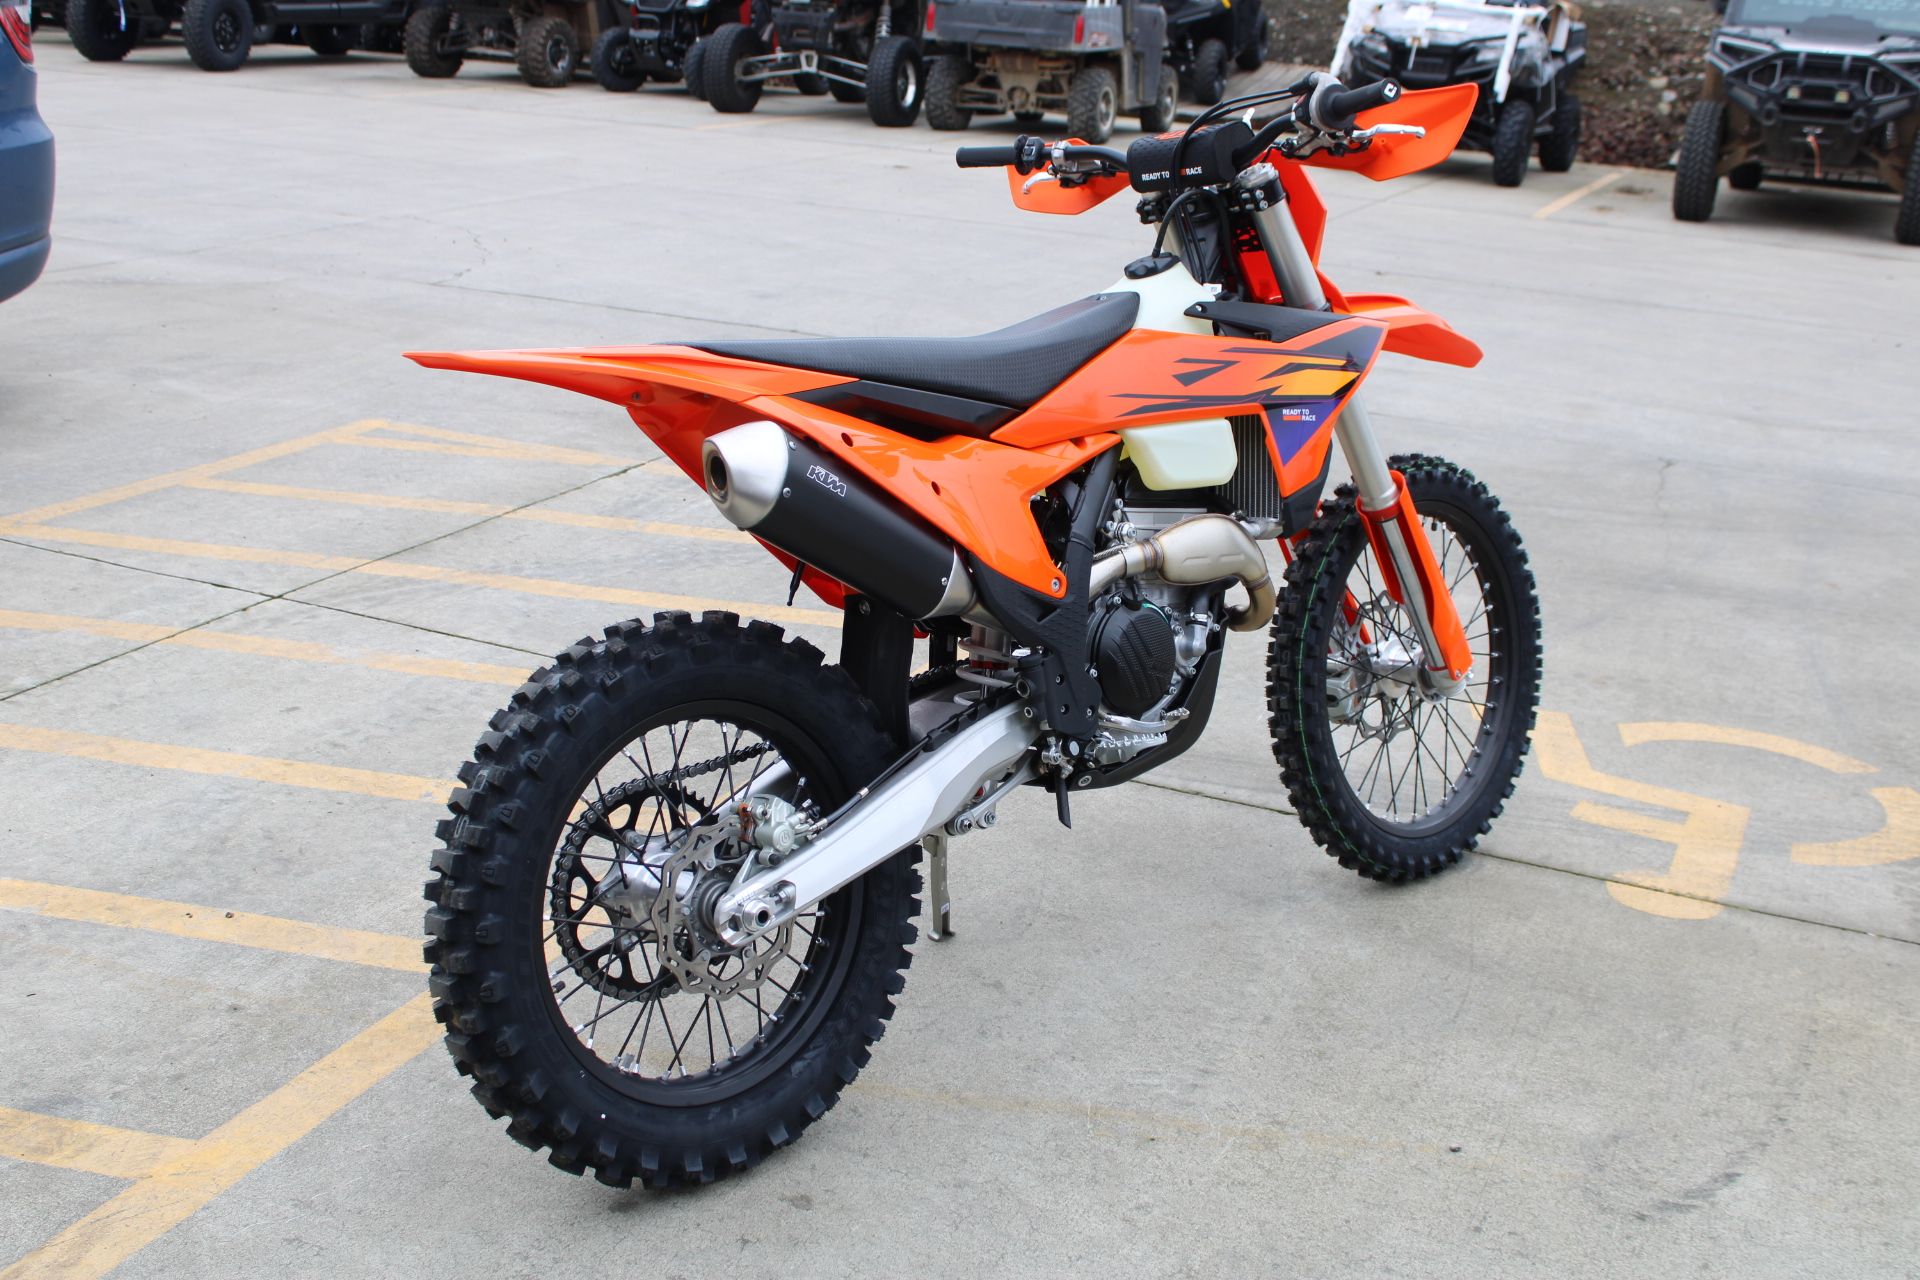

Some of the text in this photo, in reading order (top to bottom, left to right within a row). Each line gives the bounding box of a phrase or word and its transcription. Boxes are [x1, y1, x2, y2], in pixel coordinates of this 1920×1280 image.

[1142, 166, 1202, 181] READY TO RACE
[807, 465, 847, 497] KTM
